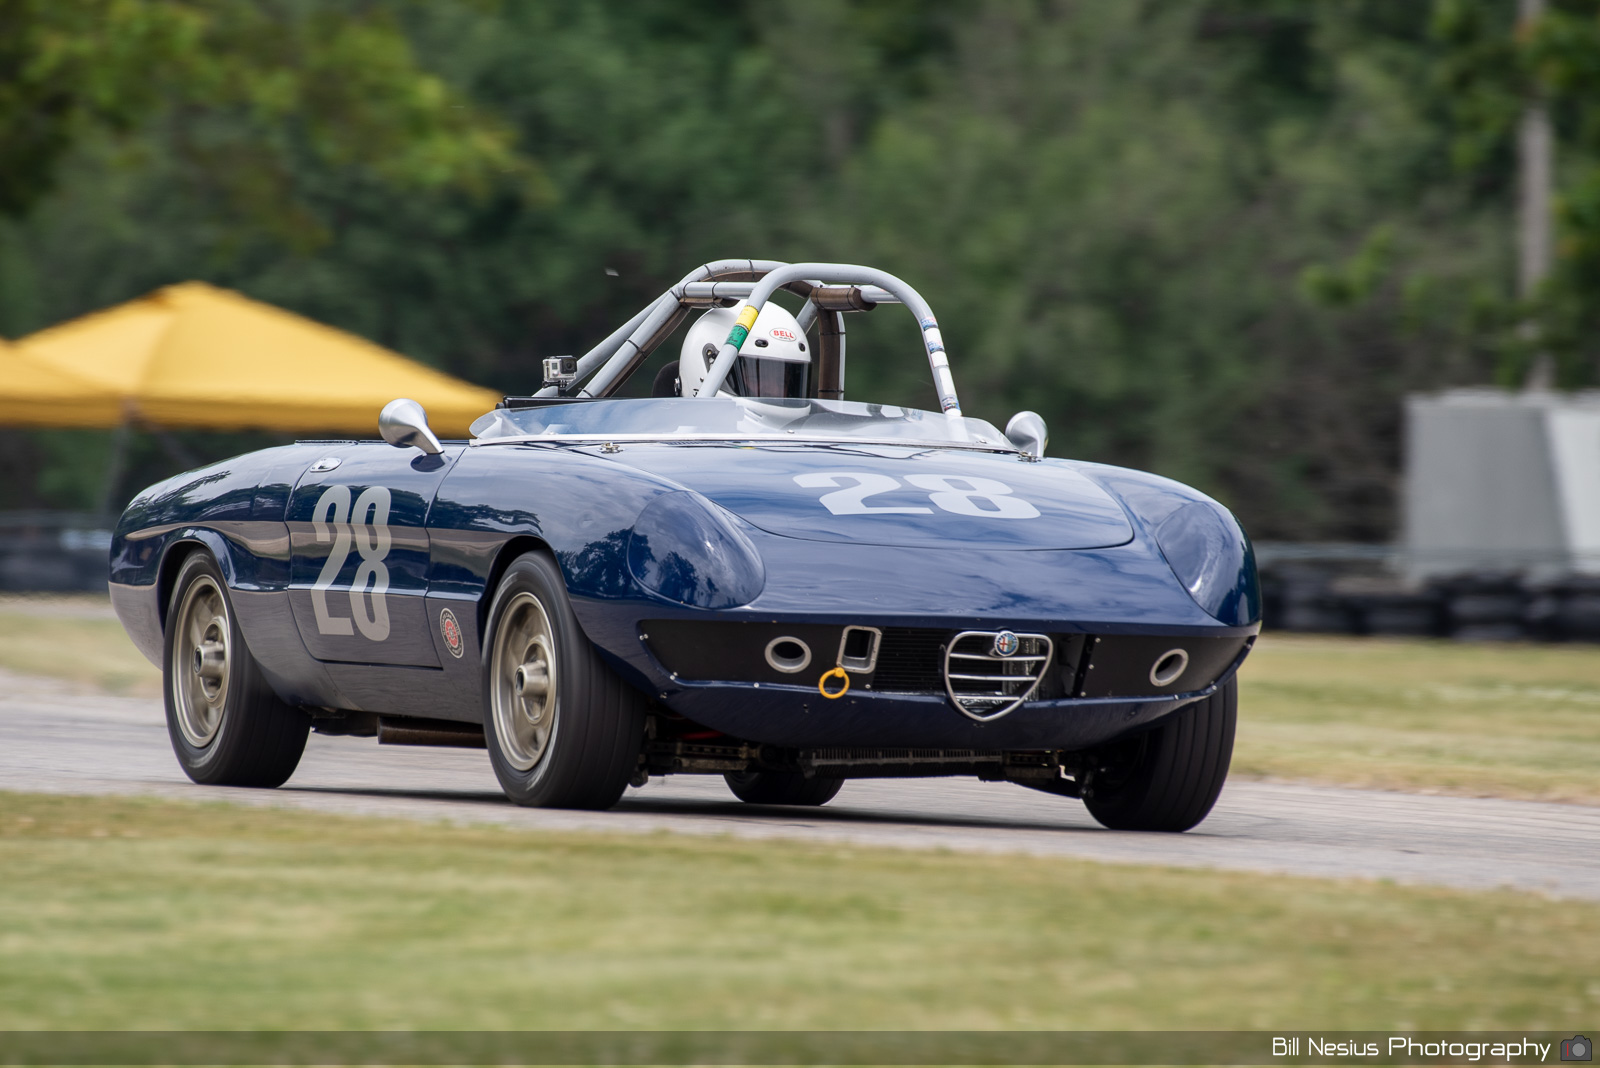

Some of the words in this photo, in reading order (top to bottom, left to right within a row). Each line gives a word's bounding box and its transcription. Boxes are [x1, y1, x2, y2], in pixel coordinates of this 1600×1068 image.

[773, 330, 795, 339] BELL
[793, 472, 1042, 519] 28
[310, 484, 392, 642] 28
